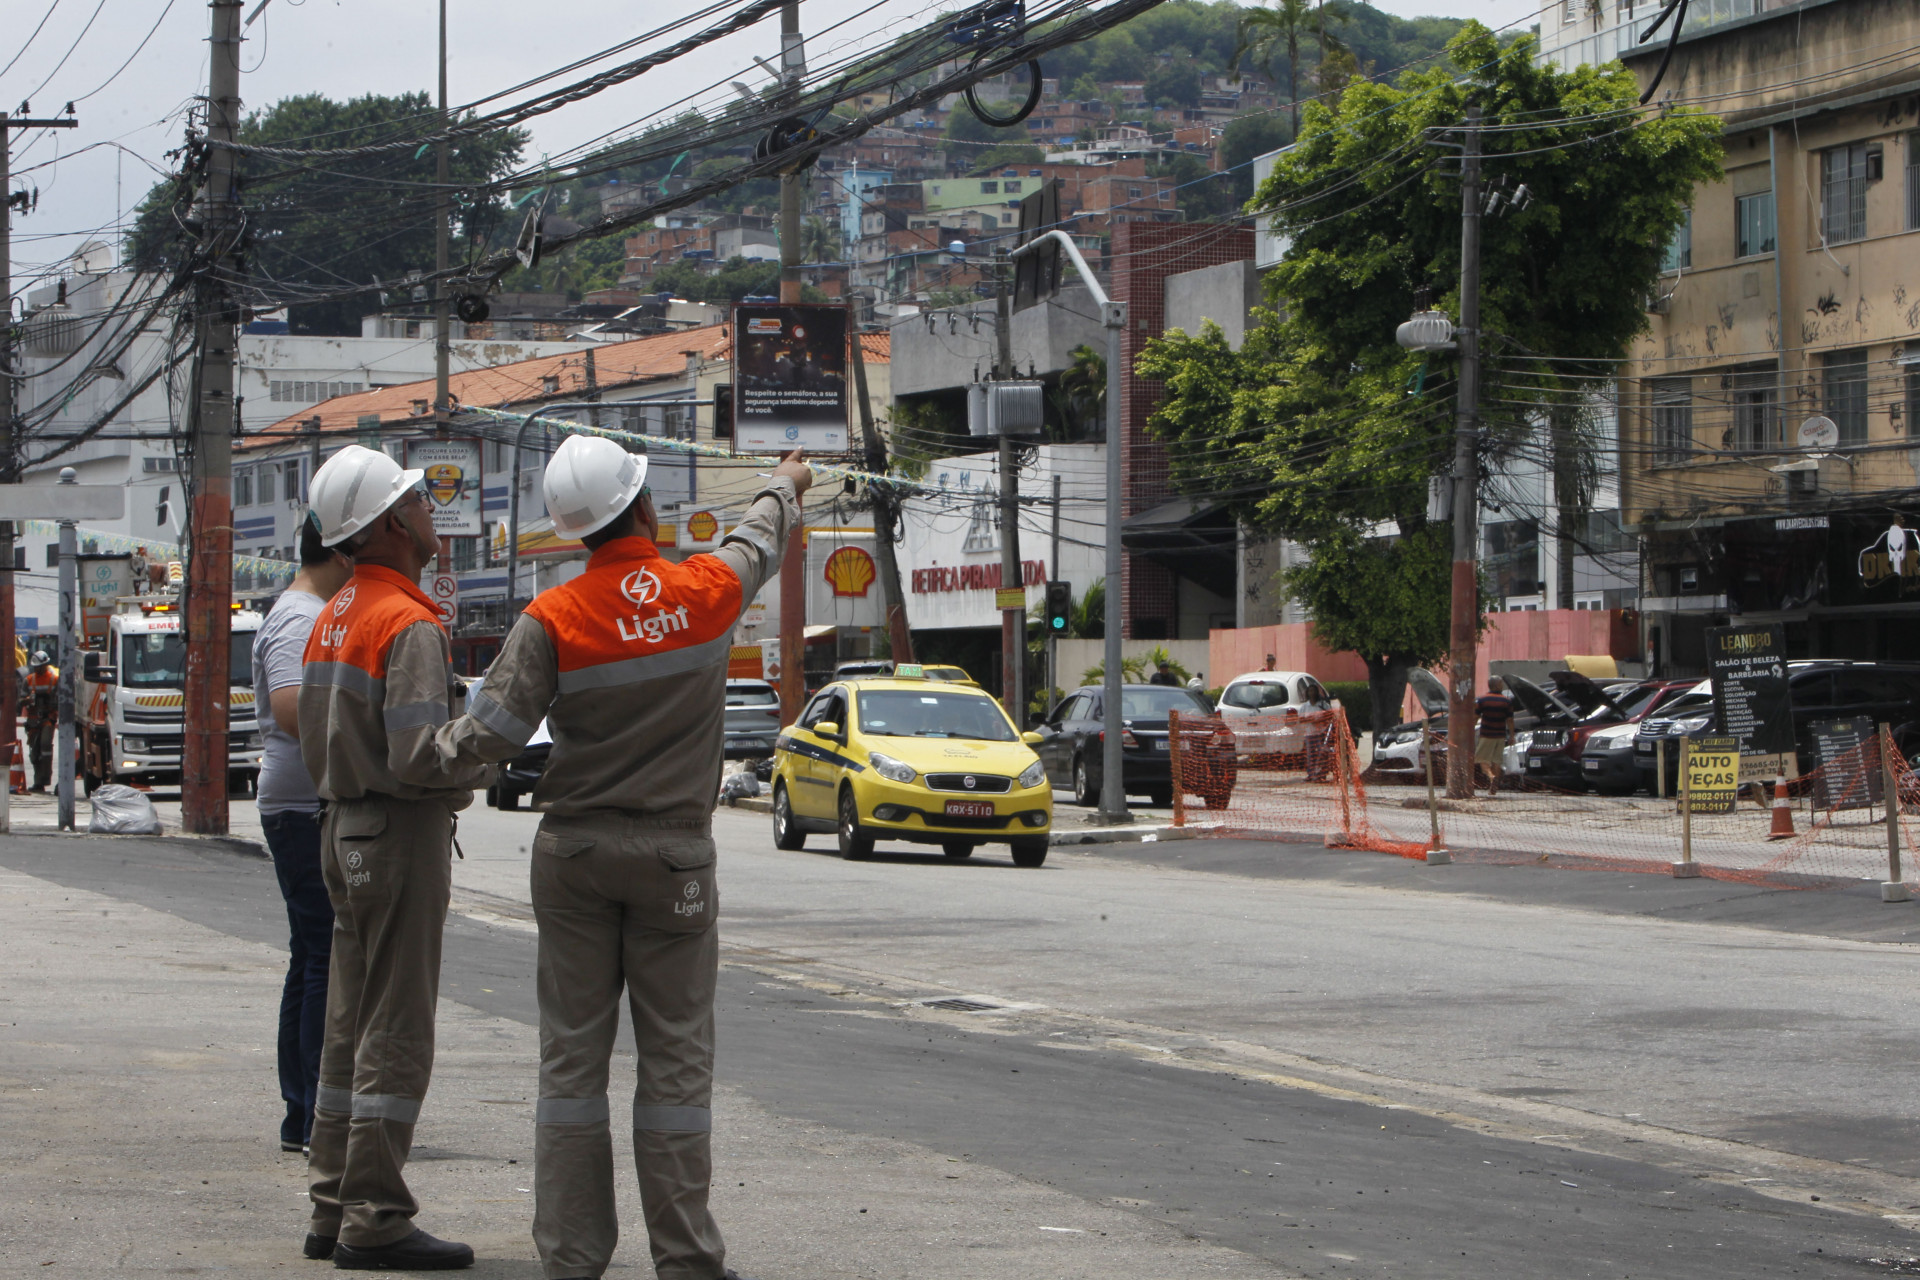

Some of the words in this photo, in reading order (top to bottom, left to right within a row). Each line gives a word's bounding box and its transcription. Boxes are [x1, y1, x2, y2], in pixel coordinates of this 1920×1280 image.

[745, 390, 777, 398] Respeite
[784, 390, 818, 398] semáforo,
[960, 562, 1003, 592] PIRAM
[1020, 560, 1047, 587] TDA
[91, 581, 118, 595] Light
[616, 605, 689, 644] Light
[1721, 632, 1772, 650] LEANDRO
[1715, 657, 1740, 668] SALÃO
[1752, 655, 1781, 664] BELEZA
[899, 665, 922, 677] TAXI
[1728, 669, 1770, 679] BARBEARIA
[1727, 720, 1764, 728] SOBRANCELHA
[1689, 756, 1731, 768] AUTO
[1690, 802, 1730, 811] 802-0117
[345, 870, 371, 887] Light
[674, 900, 704, 917] Light
